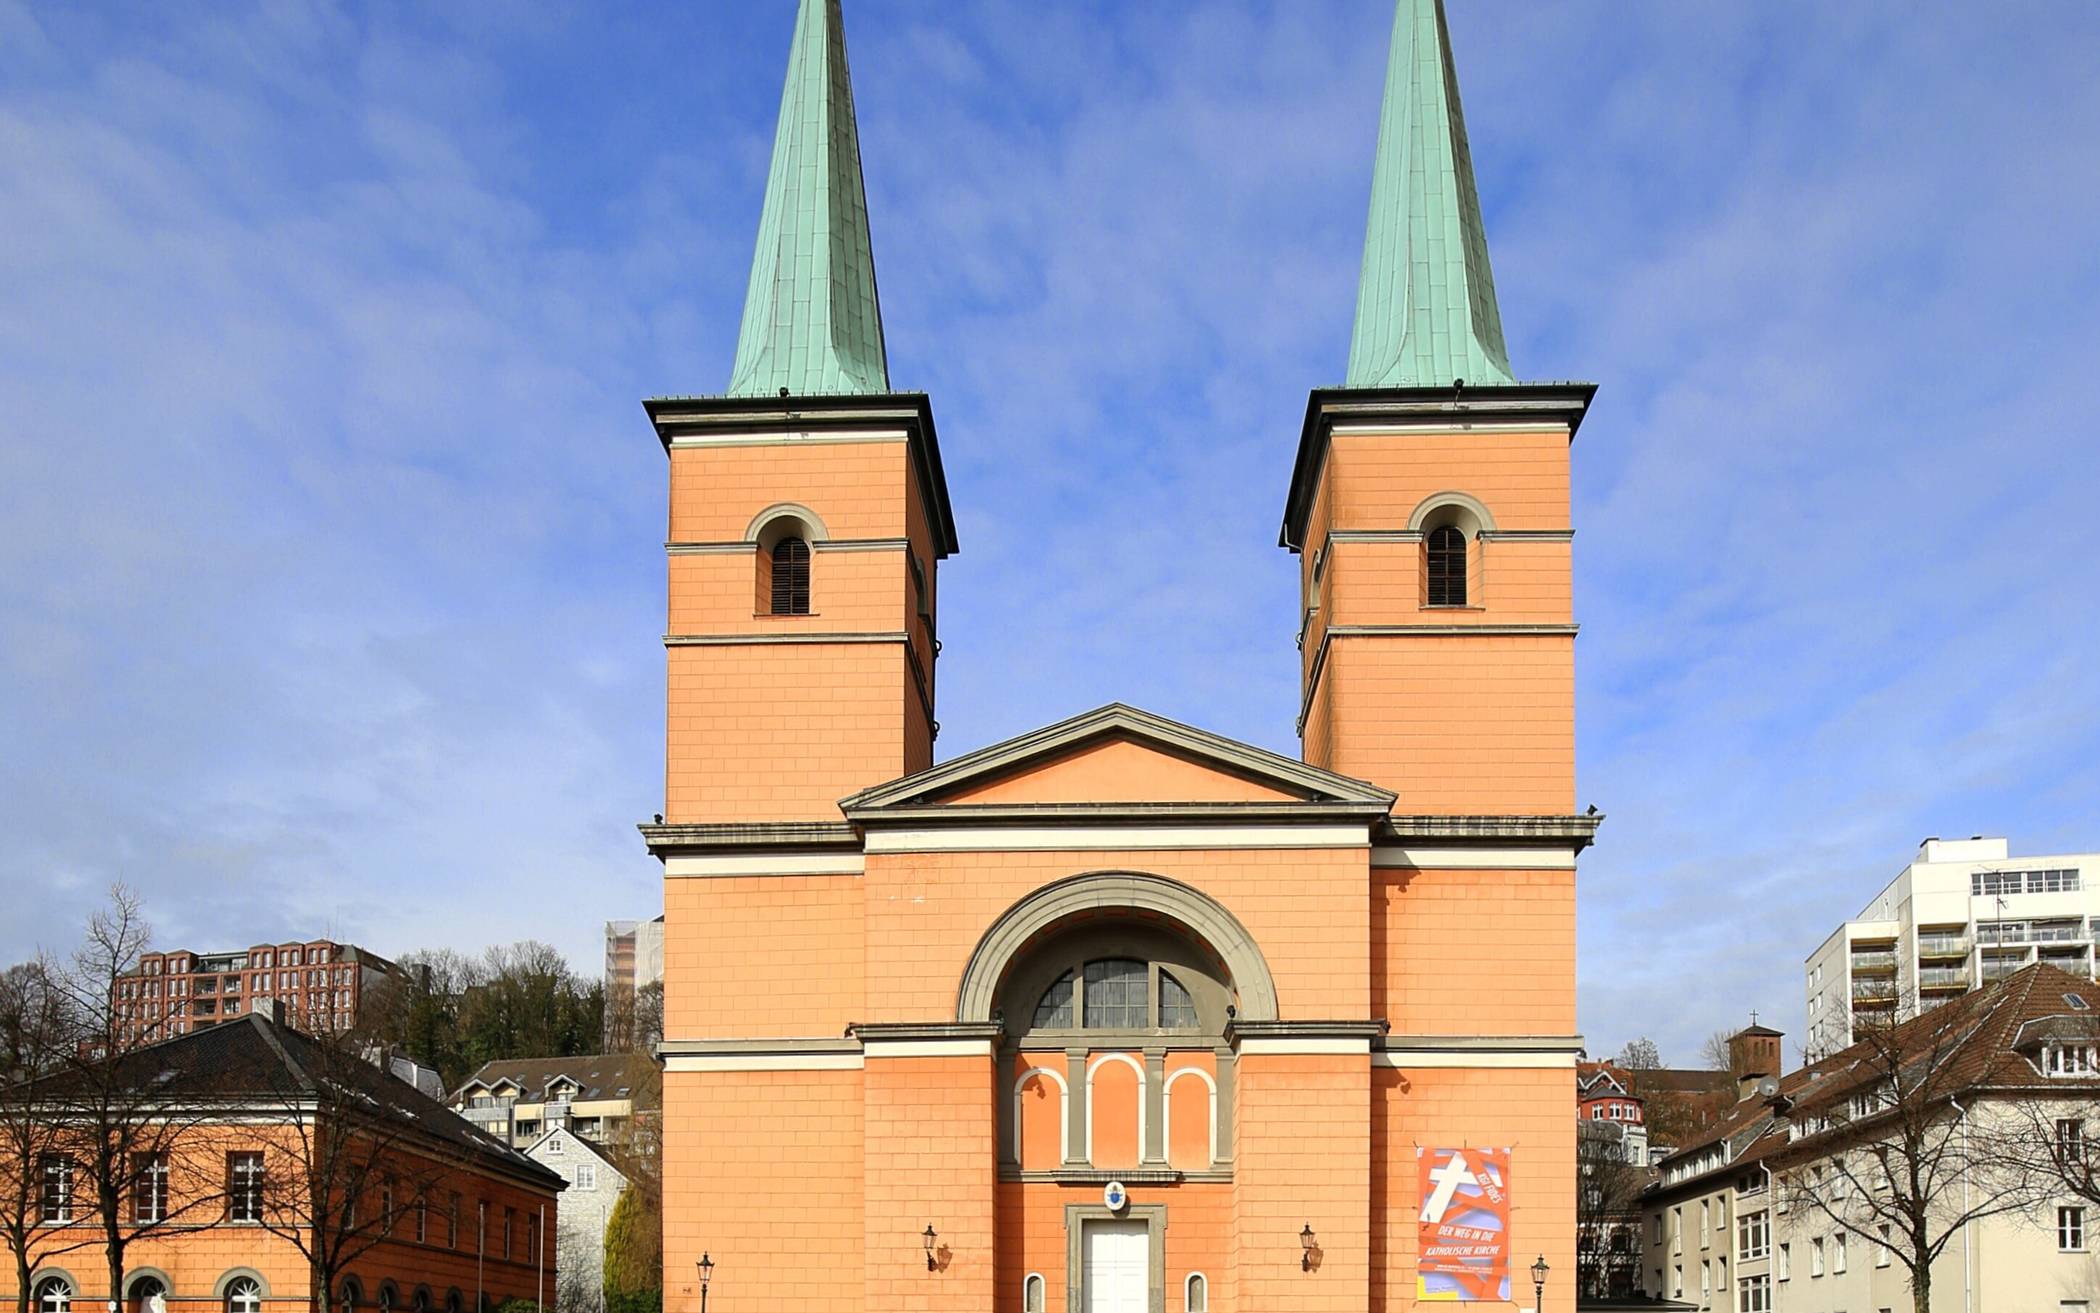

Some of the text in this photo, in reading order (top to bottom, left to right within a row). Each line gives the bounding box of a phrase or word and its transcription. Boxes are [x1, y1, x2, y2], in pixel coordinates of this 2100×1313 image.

[1438, 1225, 1496, 1242] DER WEG IN DIE
[1426, 1246, 1500, 1256] KATHOLISCHE KIRCHE
